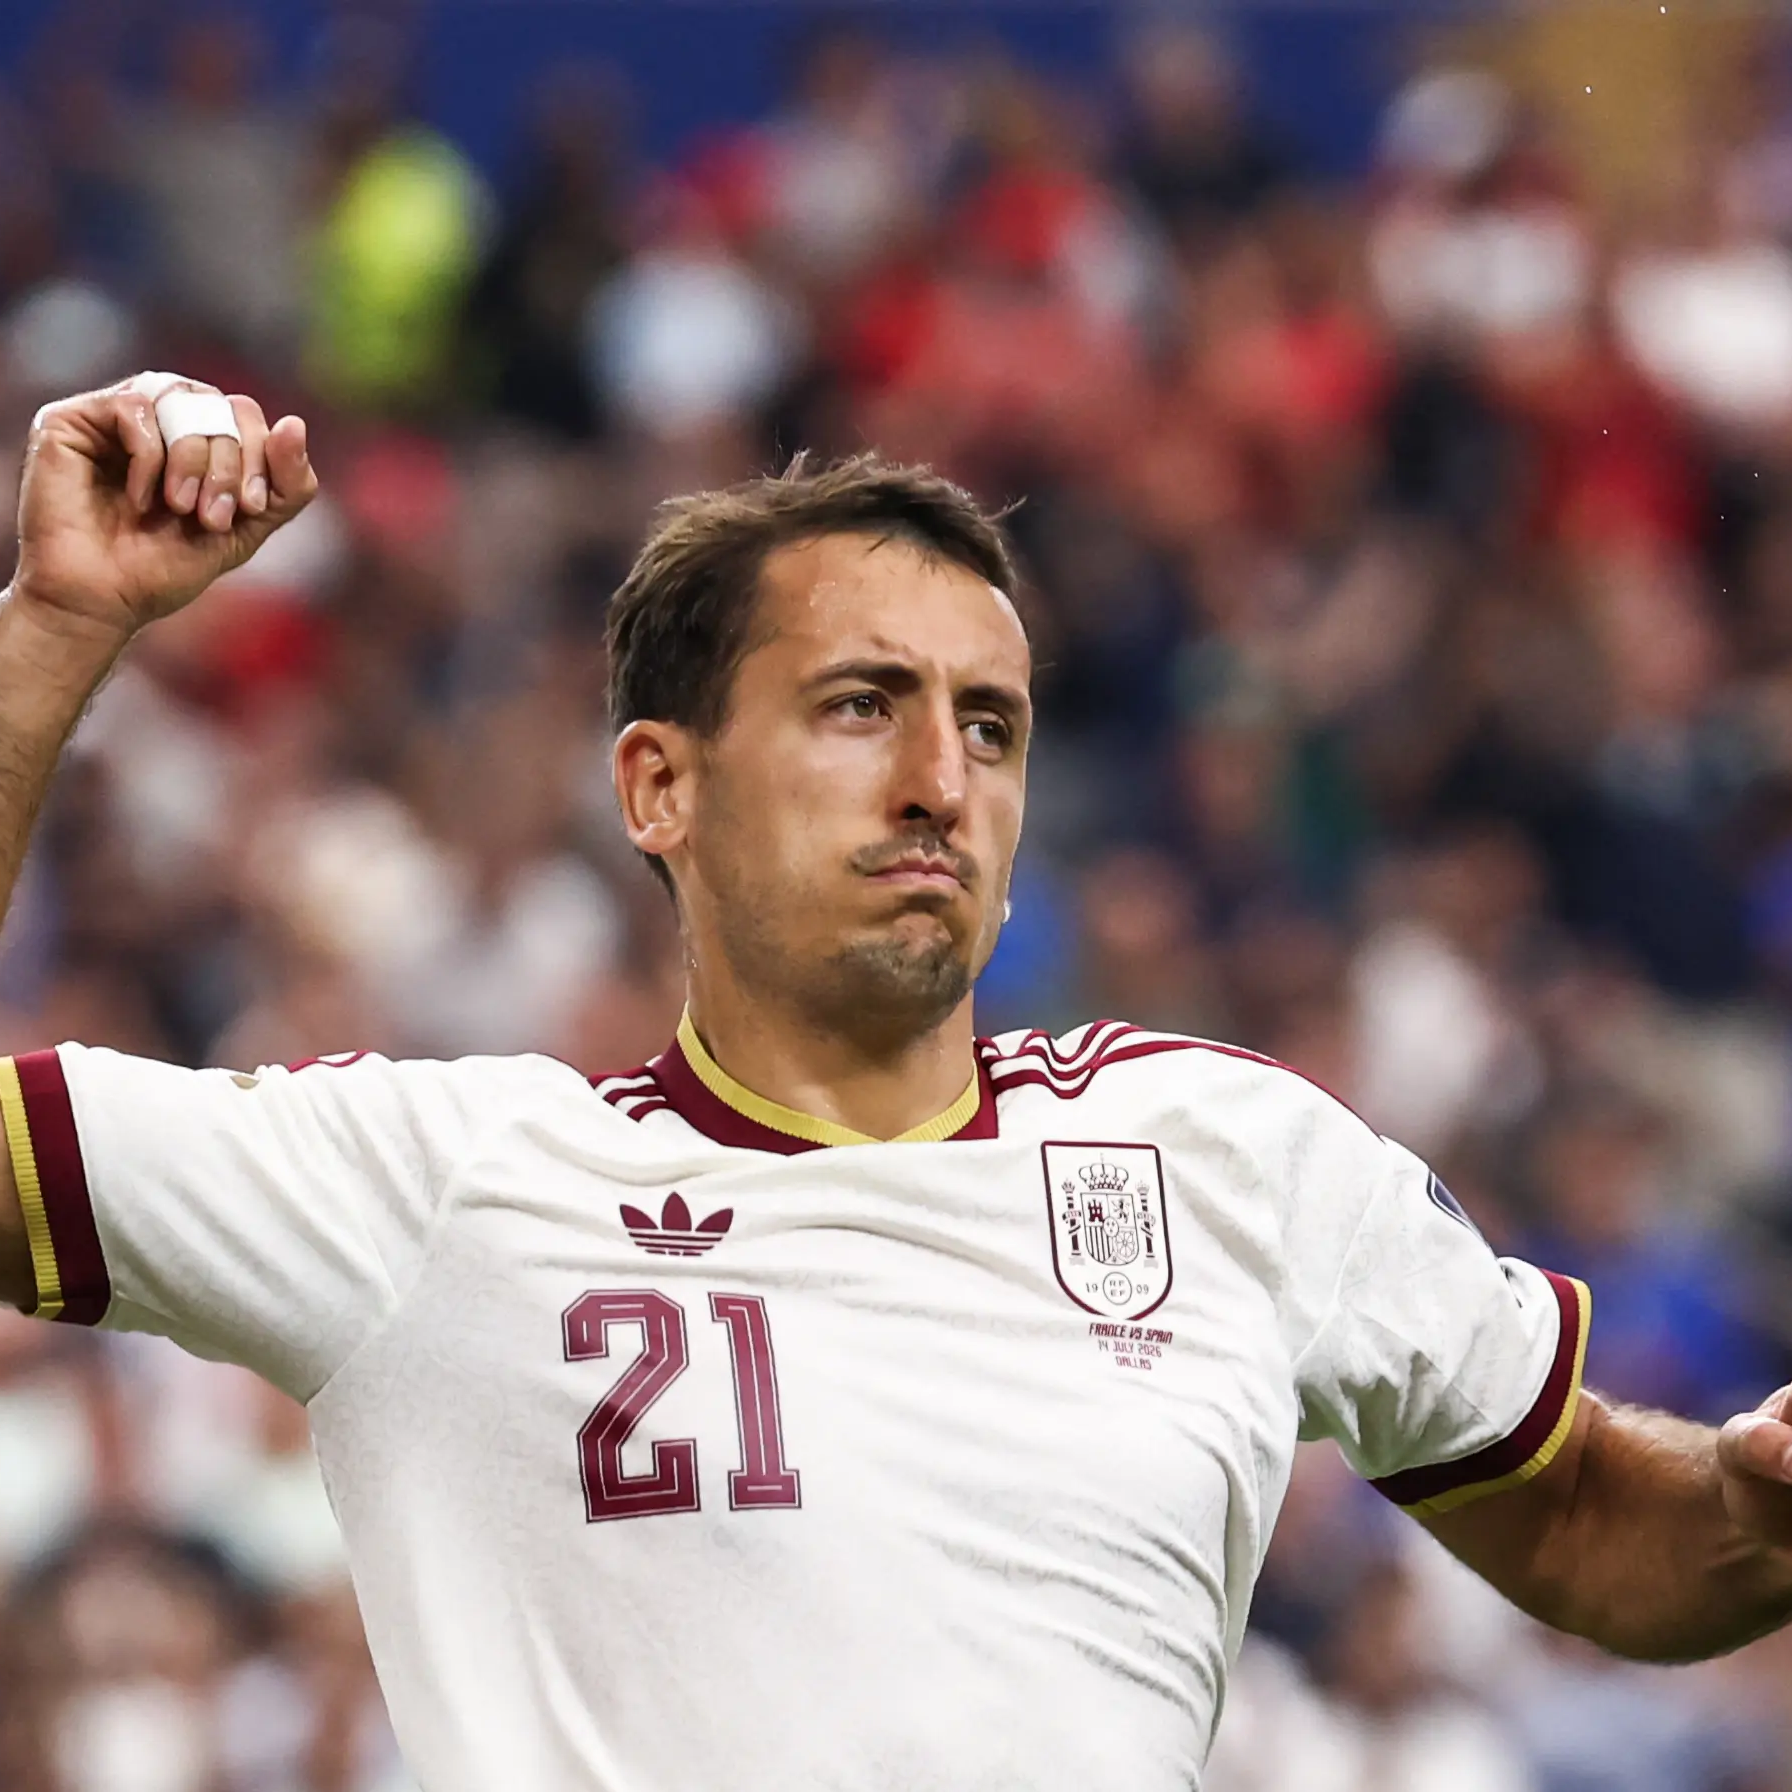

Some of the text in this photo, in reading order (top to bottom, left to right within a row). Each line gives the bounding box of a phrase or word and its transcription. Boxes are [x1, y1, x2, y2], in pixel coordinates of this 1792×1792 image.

[1089, 1322, 1173, 1345] FRANCE VS SPAIN
[1098, 1339, 1162, 1358] 14 JULY 2026
[1115, 1355, 1152, 1371] DALLAS
[561, 1288, 801, 1524] 21
